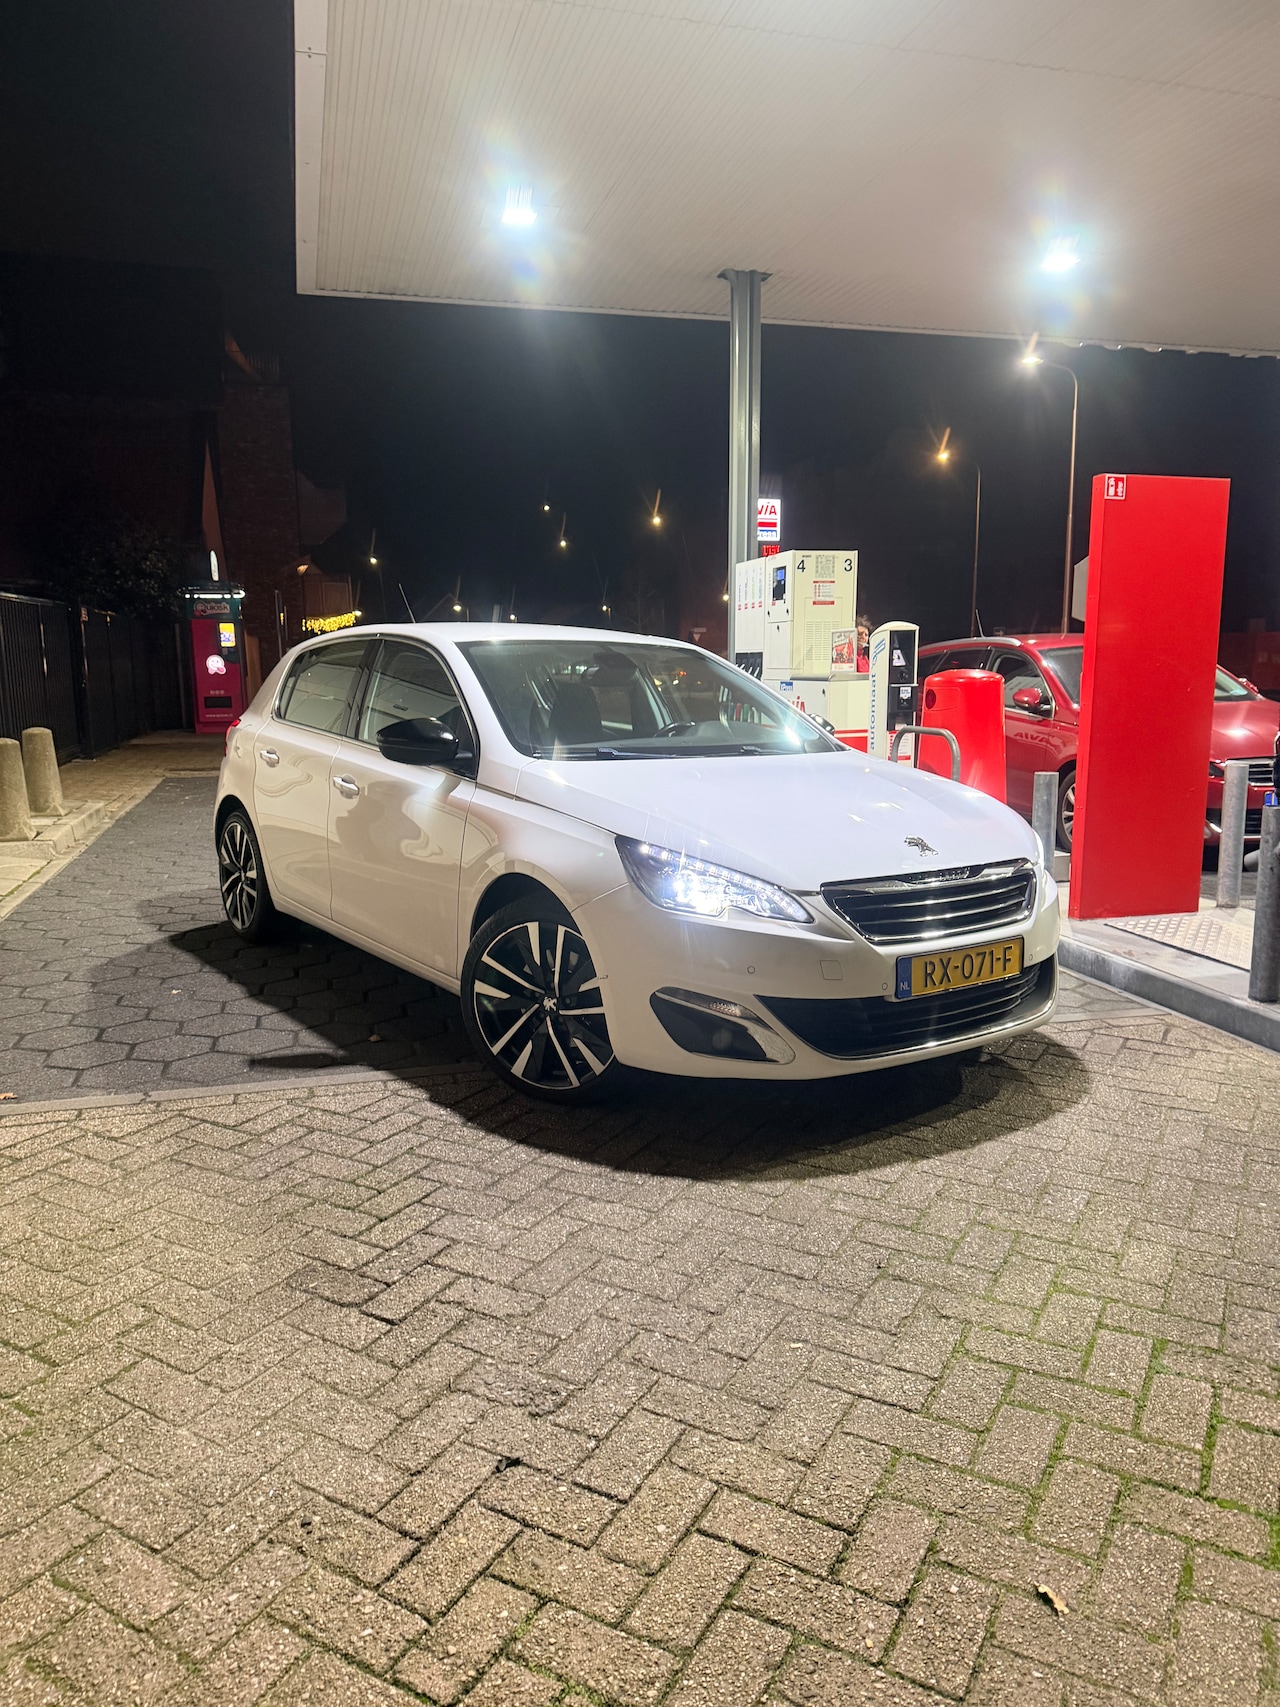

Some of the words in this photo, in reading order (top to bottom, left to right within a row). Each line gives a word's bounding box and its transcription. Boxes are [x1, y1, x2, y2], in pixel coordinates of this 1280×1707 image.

[797, 559, 806, 573] 4
[844, 558, 853, 572] 3
[924, 945, 1013, 988] RX-071-F
[900, 981, 911, 990] NL
